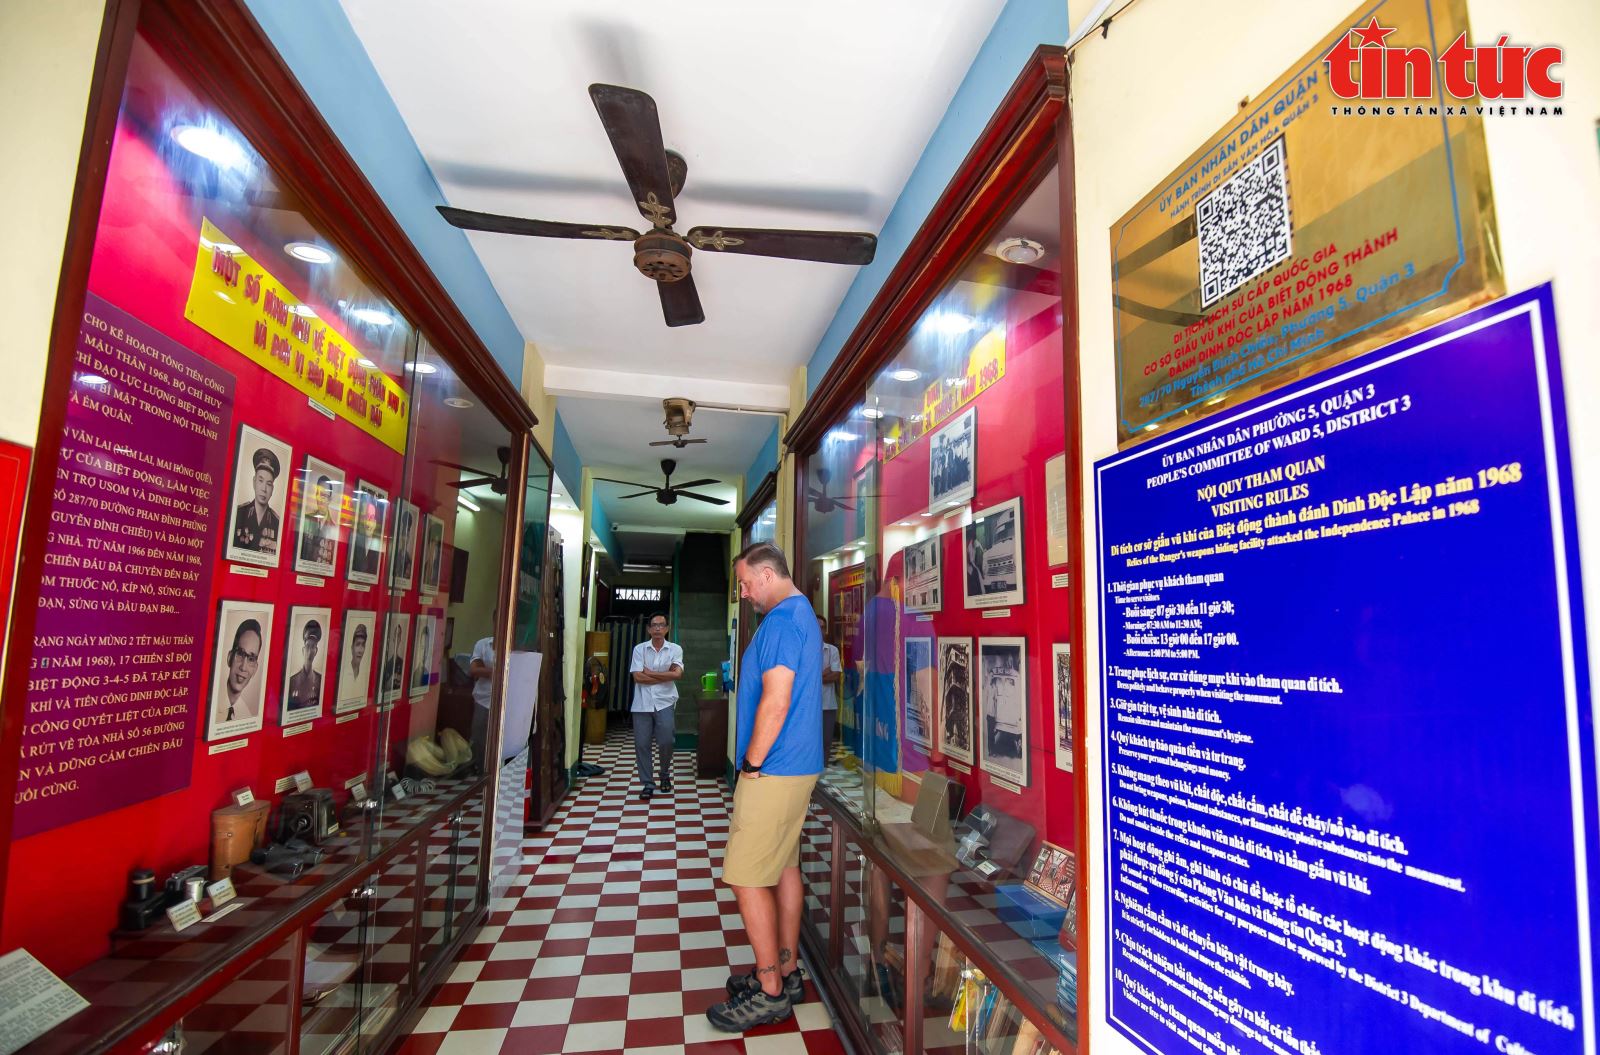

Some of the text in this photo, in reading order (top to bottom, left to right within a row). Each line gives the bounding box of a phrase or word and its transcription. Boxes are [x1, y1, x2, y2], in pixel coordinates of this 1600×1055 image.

[1147, 394, 1411, 488] PEOPLE'S COMMITTEE OF WARD 5, DISTRICT 3
[1162, 383, 1375, 467] ỦY BAN NHÂN DÂN PHƯỜNG 5, QUẬN 3
[1111, 545, 1119, 556] Di
[1120, 542, 1133, 554] tích
[1134, 542, 1143, 552] cơ
[1153, 532, 1170, 551] giấu
[1171, 533, 1181, 544] vũ
[1183, 529, 1197, 543] khí
[1198, 527, 1214, 540] của
[1216, 522, 1235, 538] Biệt
[1236, 518, 1263, 535] động
[1264, 510, 1296, 528] thành
[1298, 503, 1330, 522] đánh
[1332, 496, 1365, 516] Dinh
[1368, 490, 1397, 511] Độc
[1399, 483, 1432, 505] Lập
[1435, 476, 1473, 496] năm
[1477, 462, 1522, 488] 1968
[1197, 455, 1325, 502] NỘI QUY THAM QUAN
[1211, 483, 1309, 517] VISITING RULES
[1142, 555, 1150, 564] of
[1149, 554, 1158, 563] the
[1159, 550, 1186, 562] Ranger's
[1186, 547, 1214, 558] weapons
[1215, 542, 1238, 554] hiding
[1239, 537, 1265, 550] facility
[1266, 530, 1303, 546] attacked
[1304, 528, 1319, 540] the
[1320, 518, 1390, 537] Independence
[1392, 510, 1430, 526] Palace
[1432, 506, 1446, 520] in
[1448, 498, 1480, 517] 1968
[129, 636, 133, 645] 2
[1108, 665, 1343, 693] 2. Trang phục lịch sự, cư xử đúng mực khi vào tham quan di tích.
[1323, 914, 1575, 1030] các hoạt động khác trong khu di tích
